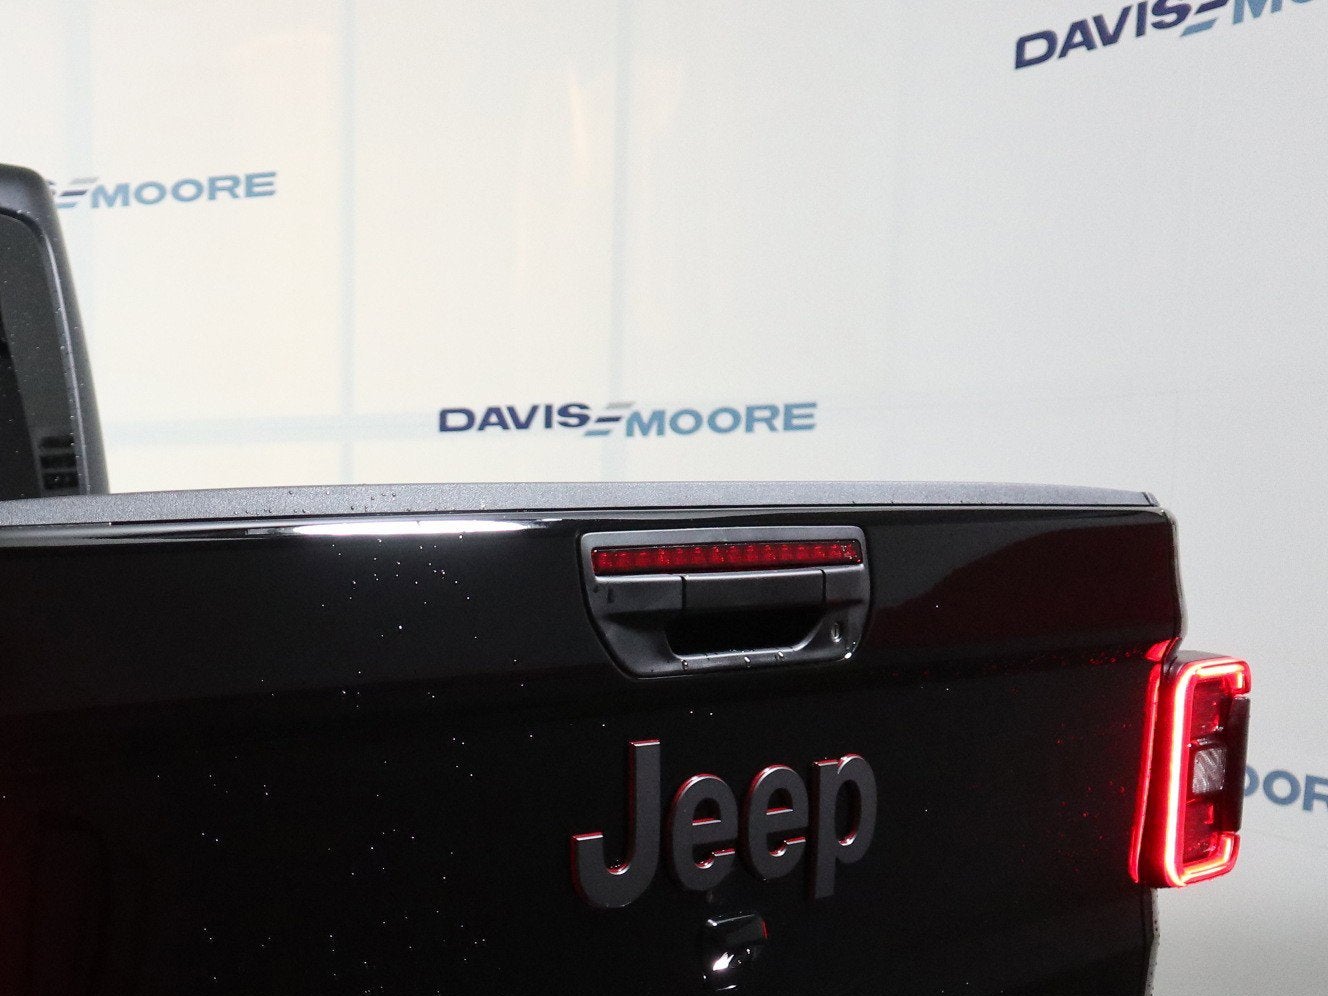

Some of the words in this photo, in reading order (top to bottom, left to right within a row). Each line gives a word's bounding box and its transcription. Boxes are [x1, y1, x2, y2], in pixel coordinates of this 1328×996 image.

[1015, 0, 1192, 69] DAVIS
[91, 171, 276, 208] MOORE
[438, 403, 589, 432] DAVIS
[625, 402, 817, 437] MOORE
[569, 738, 877, 909] Jeep
